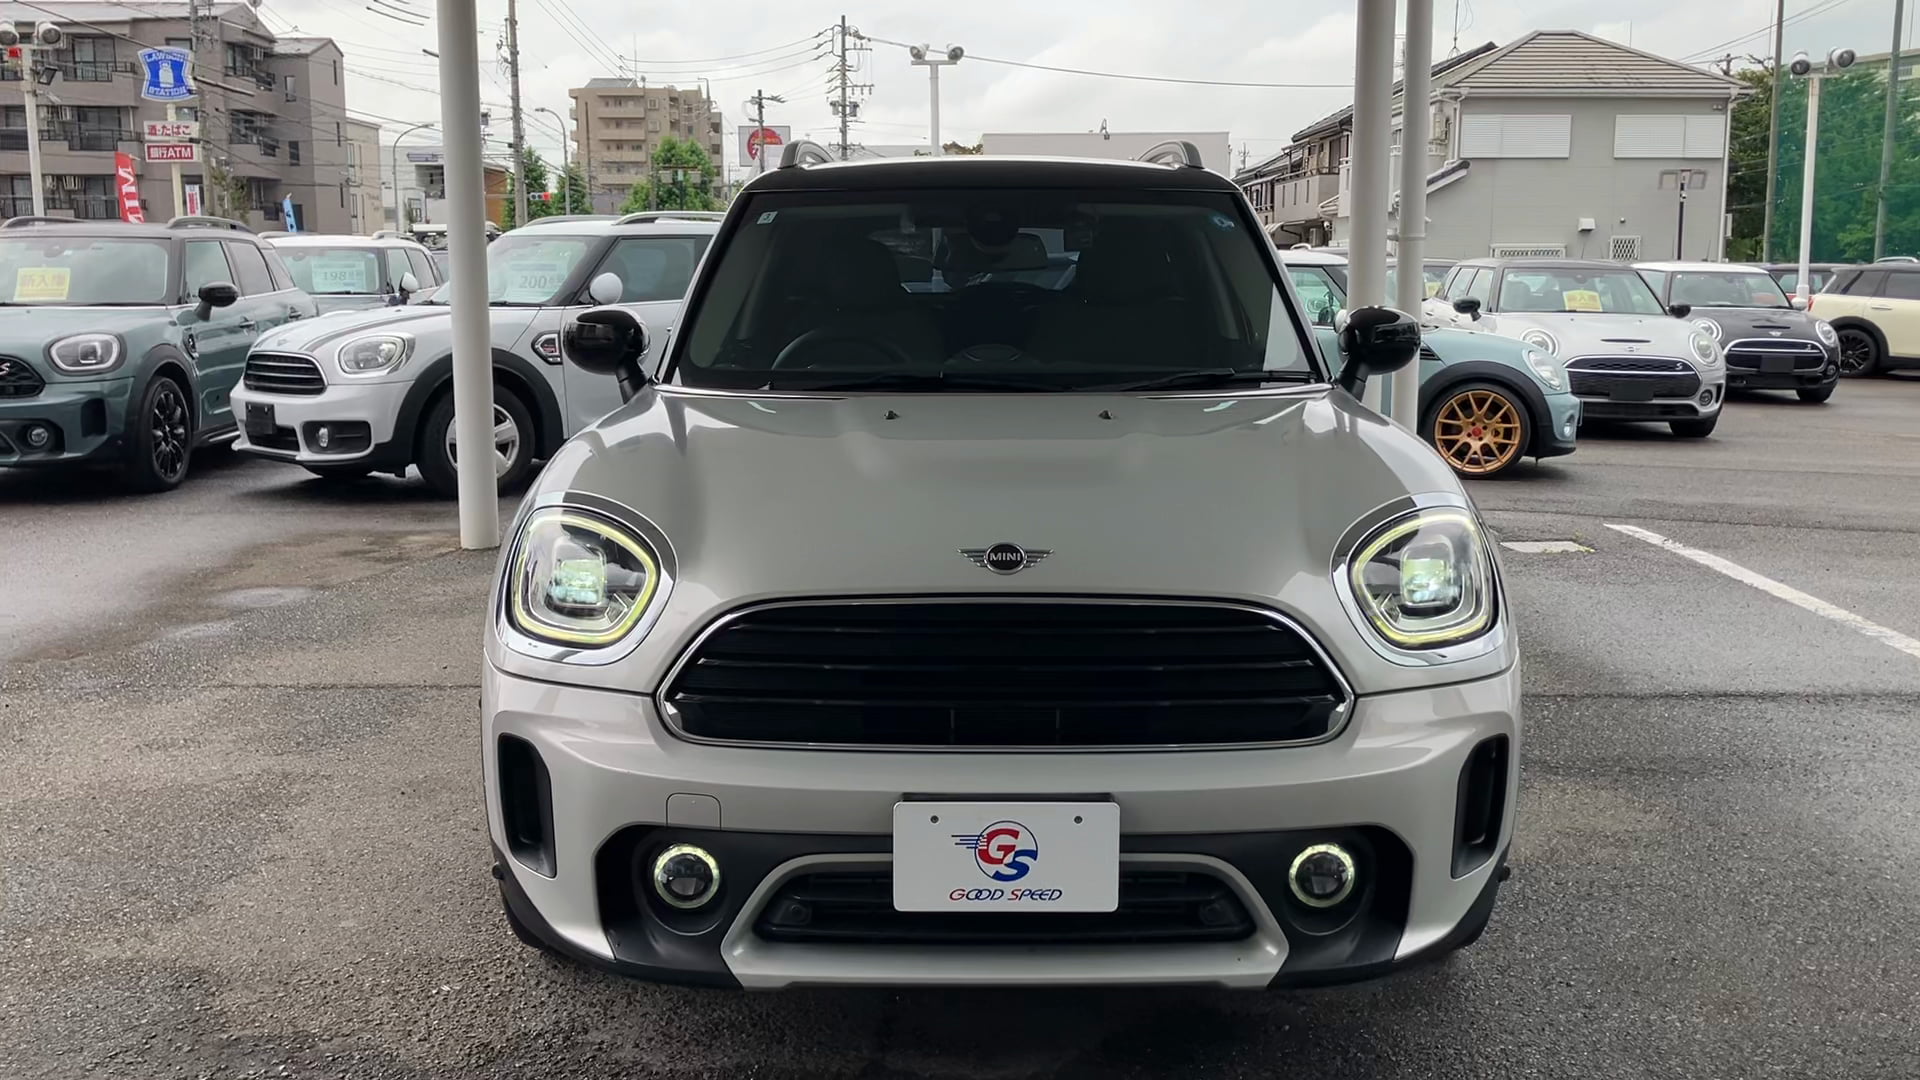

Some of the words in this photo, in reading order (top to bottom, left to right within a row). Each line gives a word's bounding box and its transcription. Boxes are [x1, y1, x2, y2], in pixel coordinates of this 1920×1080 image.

[989, 552, 1021, 561] MINI
[949, 888, 1004, 901] GOOD
[1008, 888, 1062, 901] SPEED
